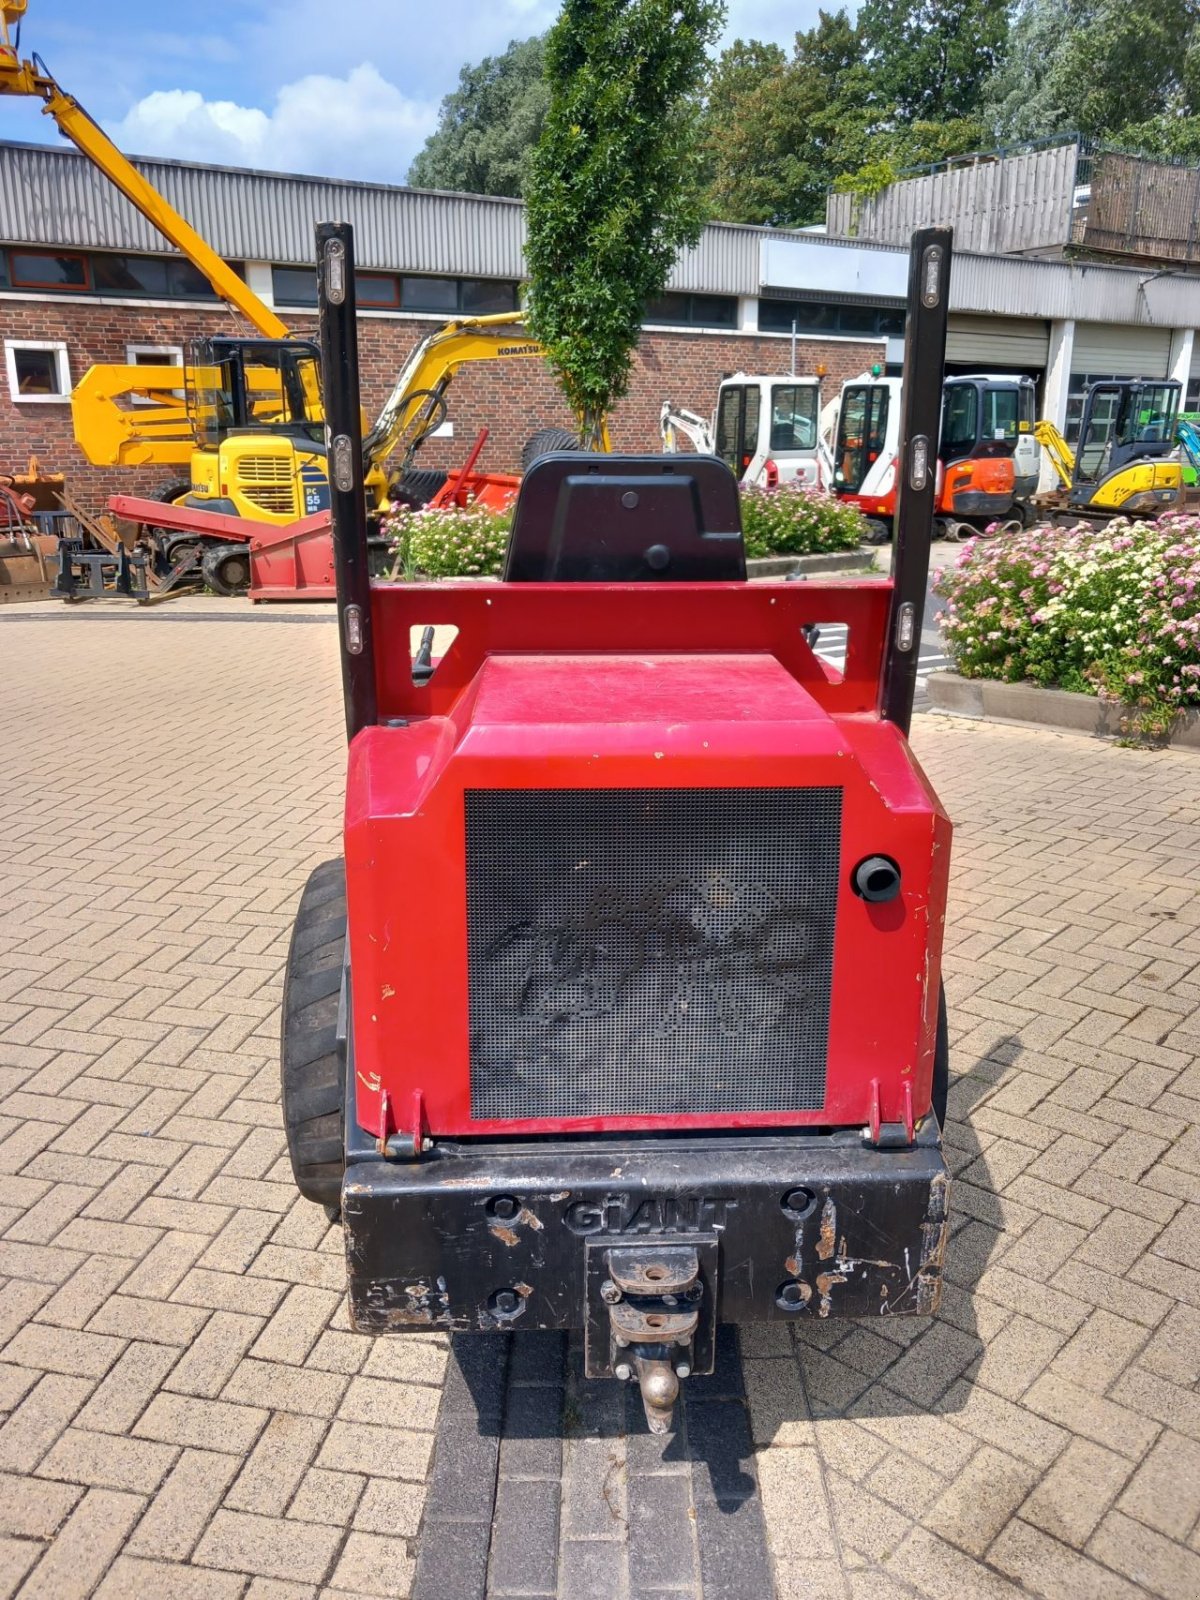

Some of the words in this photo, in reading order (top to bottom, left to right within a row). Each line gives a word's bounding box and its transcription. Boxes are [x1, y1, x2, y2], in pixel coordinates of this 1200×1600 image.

[497, 344, 539, 356] KOMATSU
[306, 487, 317, 495] PC
[306, 495, 321, 505] 55
